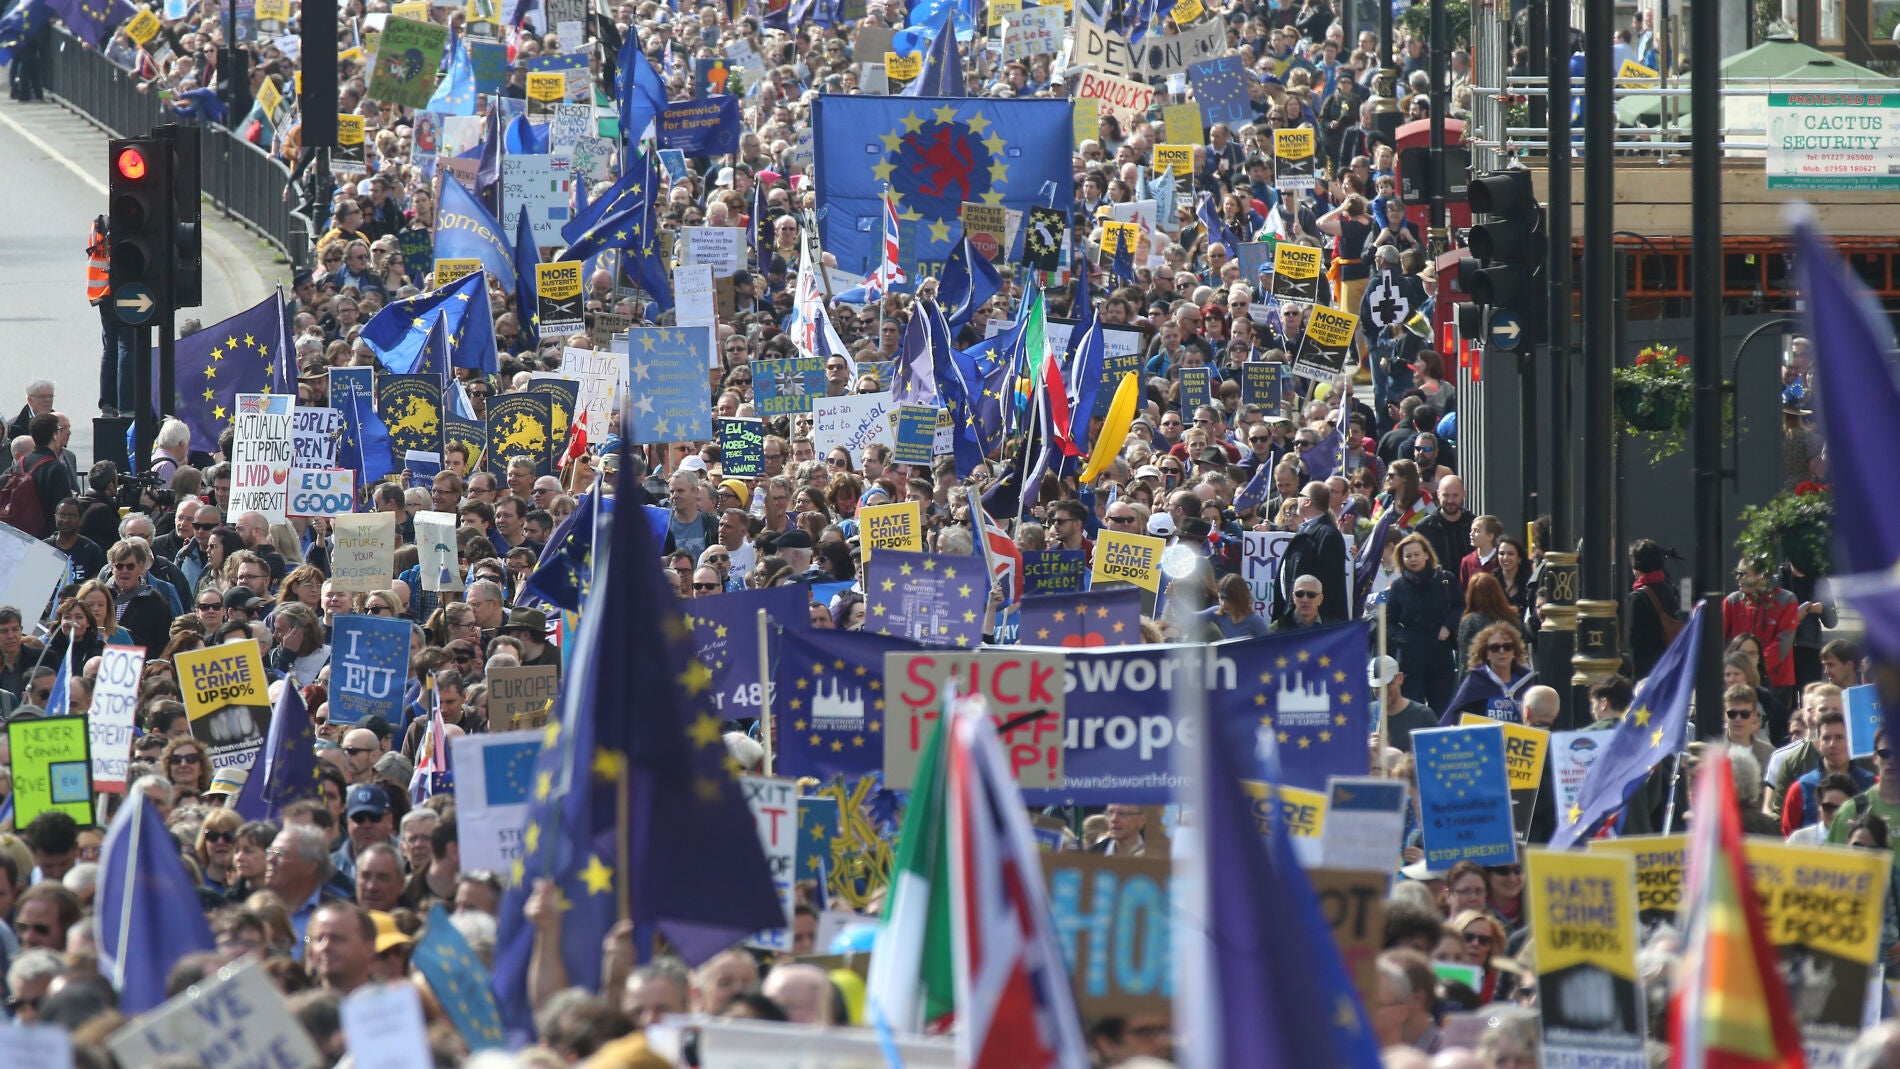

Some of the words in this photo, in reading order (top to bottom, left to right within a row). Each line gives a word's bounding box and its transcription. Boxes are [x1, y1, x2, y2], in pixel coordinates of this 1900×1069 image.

[1197, 59, 1231, 76] WE
[1081, 75, 1153, 113] BOLLOCKS
[1789, 94, 1862, 106] PROTECTED
[1867, 94, 1884, 106] BY
[664, 105, 721, 119] Greenwich
[1208, 102, 1243, 126] EU
[341, 119, 360, 129] ORE
[664, 121, 679, 131] for
[683, 117, 721, 131] Europe
[1804, 116, 1883, 130] CACTUS
[1279, 134, 1309, 143] MORE
[1783, 136, 1881, 150] SECURITY
[1158, 150, 1189, 158] MORE
[967, 205, 1002, 214] BREXIT
[967, 213, 986, 223] CAN
[989, 216, 1001, 225] BE
[1280, 259, 1315, 268] AUSTERITY
[1281, 249, 1315, 263] MORE
[541, 268, 577, 281] MORE
[1296, 267, 1315, 275] BREXIT
[541, 279, 578, 289] AUSTERITY
[542, 289, 558, 298] OVER
[559, 286, 578, 295] BREXIT
[1313, 322, 1349, 336] AUSTERITY
[1315, 312, 1352, 330] MORE
[547, 324, 584, 335] EUROPEAN
[1311, 329, 1328, 337] OVER
[1329, 332, 1347, 344] BREXIT
[1111, 343, 1130, 351] WILL
[564, 353, 618, 375] PULLING
[783, 360, 793, 373] A
[1115, 356, 1139, 368] THE
[1248, 366, 1275, 374] NEVER
[1247, 373, 1276, 381] GONNA
[1189, 398, 1201, 406] EU
[1255, 391, 1269, 399] EU
[819, 407, 838, 420] put
[840, 405, 851, 415] an
[237, 415, 291, 441] ACTUALLY
[293, 412, 337, 434] EOPLE
[819, 419, 835, 431] end
[841, 418, 850, 430] to
[725, 423, 742, 434] EU
[741, 430, 763, 446] 2012
[858, 423, 883, 451] crisis
[237, 441, 291, 463] FLIPPING
[293, 437, 337, 460] REN'T
[722, 440, 749, 450] NOBEL
[236, 464, 270, 488] LIVID
[729, 464, 756, 474] WINNER
[301, 473, 332, 490] EU
[231, 490, 287, 511] #NOBREXIT
[293, 493, 354, 514] GOOD
[869, 513, 910, 529] HATE
[358, 526, 372, 537] MY
[871, 524, 911, 540] CRIME
[352, 552, 374, 562] YOUR
[1041, 552, 1060, 562] UK
[1106, 541, 1153, 559] HATE
[1105, 553, 1151, 570] CRIME
[1037, 576, 1078, 588] NEEDS
[994, 623, 1020, 640] TAY
[346, 630, 363, 661] I
[100, 651, 144, 688] SOS
[191, 655, 250, 678] HATE
[1062, 654, 1238, 693] sworth
[194, 669, 253, 692] CRIME
[340, 662, 397, 699] EU
[492, 675, 558, 700] EUROPE
[901, 656, 1056, 708] SUCK
[93, 692, 140, 716] STOP
[506, 702, 516, 714] IS
[23, 726, 73, 744] NEVER
[1062, 714, 1200, 761] urope
[23, 746, 70, 763] GONNA
[1506, 736, 1538, 758] RE
[213, 751, 256, 769] EUROP
[61, 776, 78, 788] EU
[1429, 849, 1460, 861] STOP
[1464, 844, 1510, 858] BREXIT!
[1545, 876, 1616, 898] HATE
[1794, 869, 1875, 891] SPIKE
[1638, 889, 1684, 905] FOO
[1782, 890, 1868, 915] PRICE
[1319, 886, 1378, 941] OT
[1548, 902, 1618, 929] CRIME
[1784, 917, 1869, 944] FOOD
